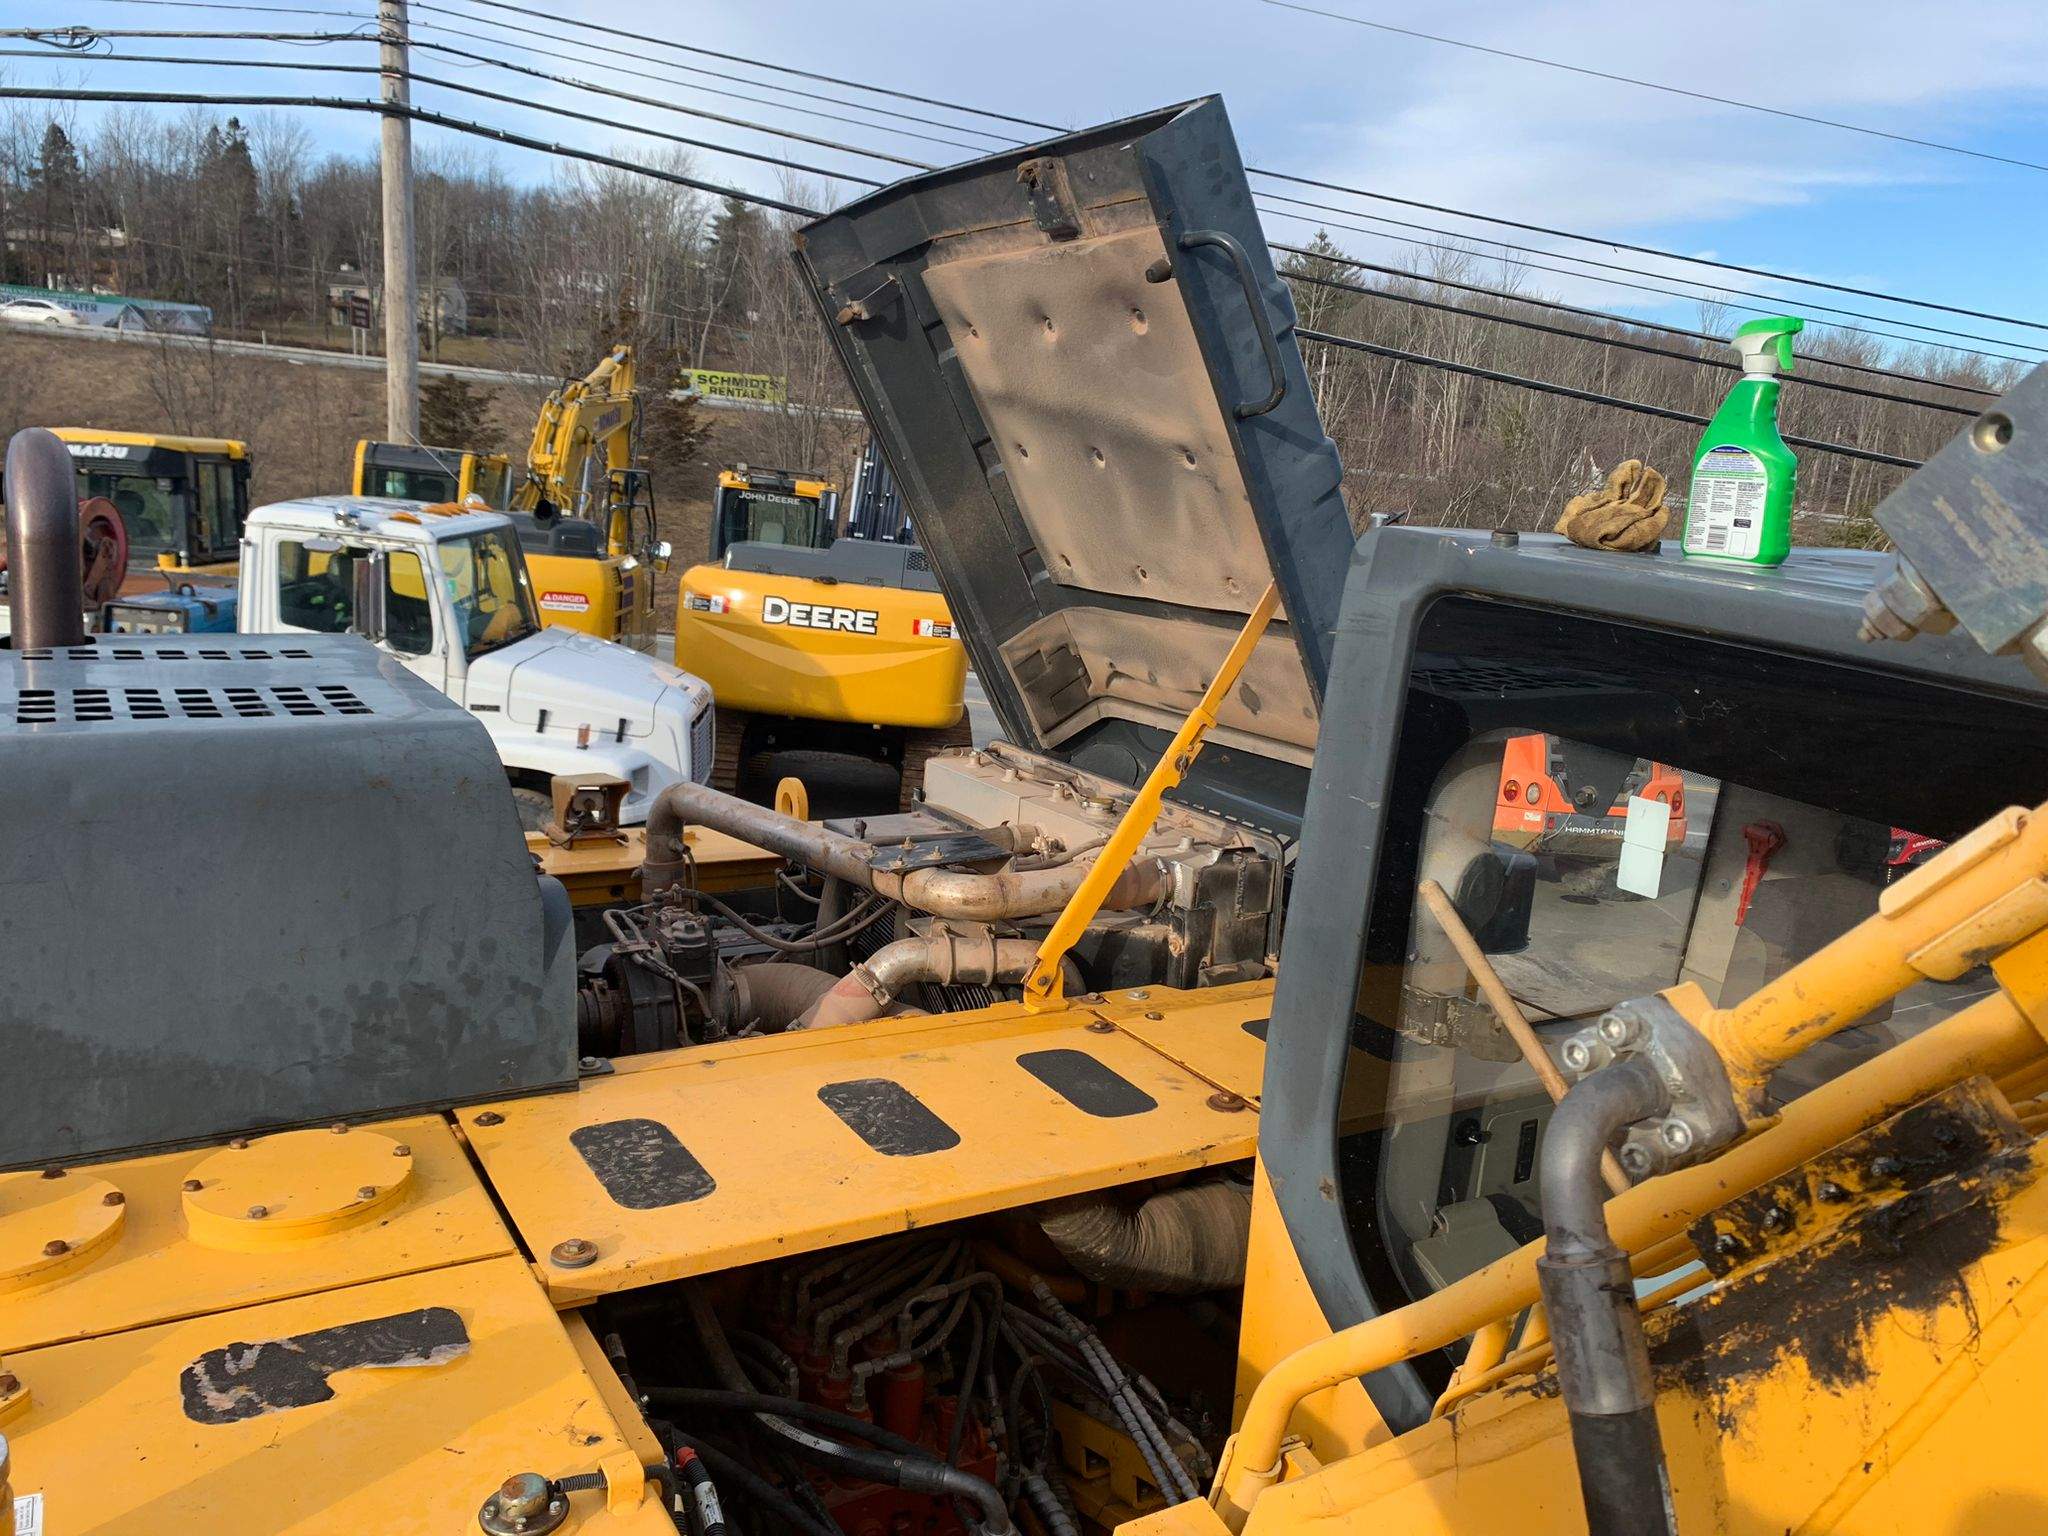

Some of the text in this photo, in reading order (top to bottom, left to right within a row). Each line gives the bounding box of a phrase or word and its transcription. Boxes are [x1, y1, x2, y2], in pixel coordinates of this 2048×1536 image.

[709, 386, 767, 400] RENTALS
[66, 443, 130, 459] MATSU
[739, 491, 801, 506] JOHN DEERE
[552, 593, 586, 604] DANGER
[762, 595, 879, 635] DEERE
[1564, 826, 1625, 837] HAMMTRONI
